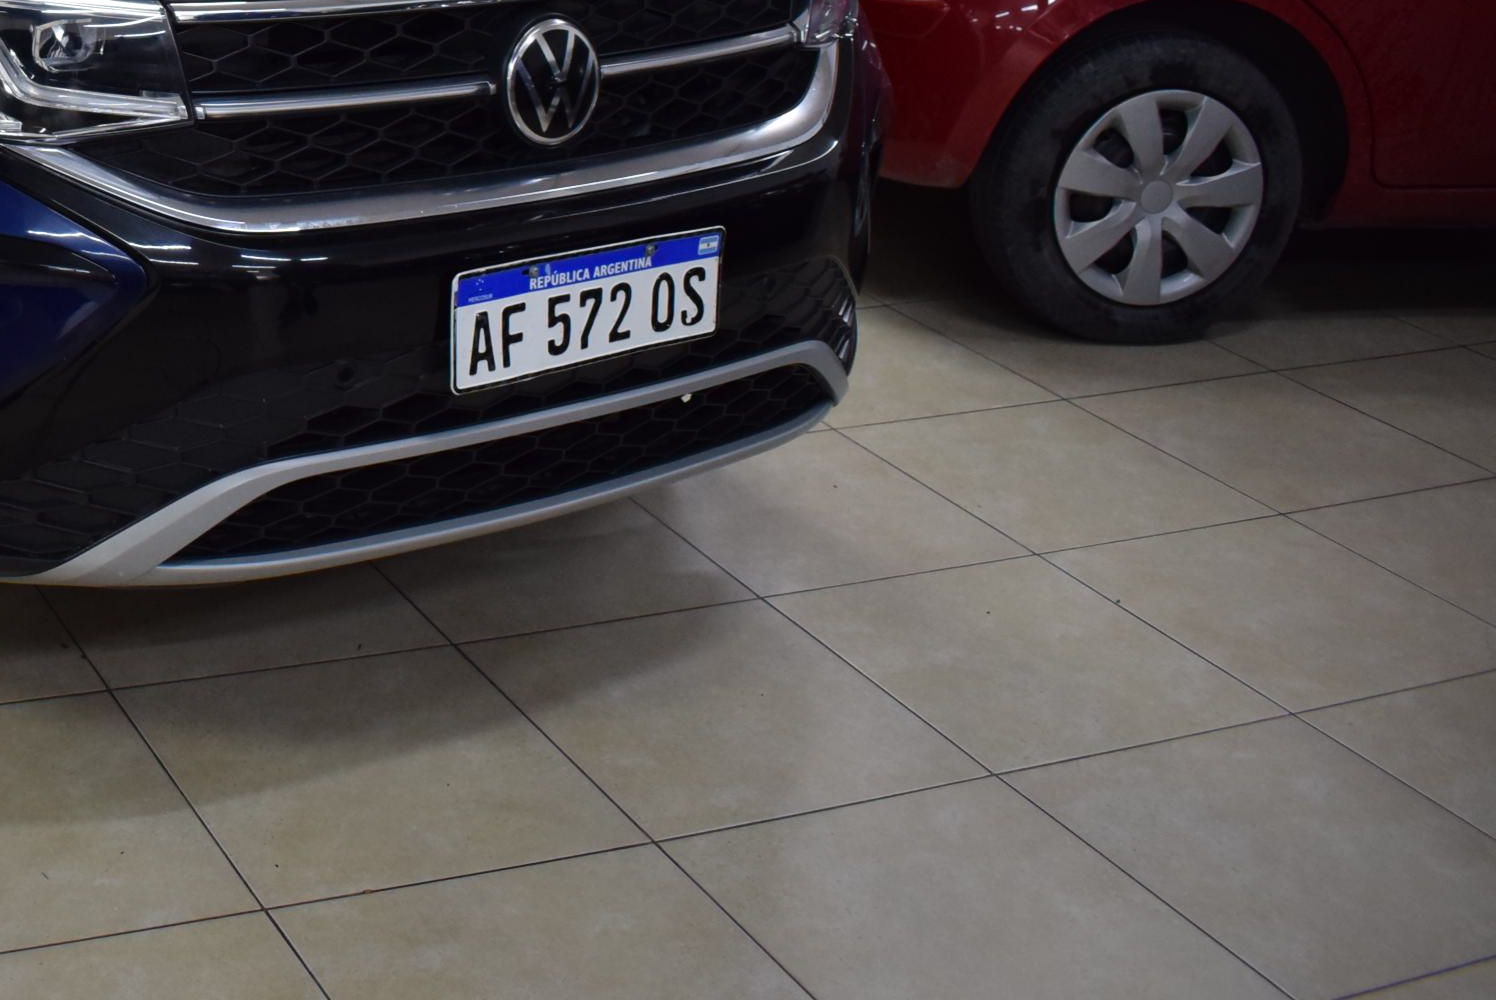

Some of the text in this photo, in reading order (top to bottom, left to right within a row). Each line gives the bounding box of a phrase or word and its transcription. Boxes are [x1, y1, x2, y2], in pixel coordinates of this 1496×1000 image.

[529, 257, 653, 291] REPÚBLICA ARGENTINA
[469, 267, 706, 376] AF 572 OS
